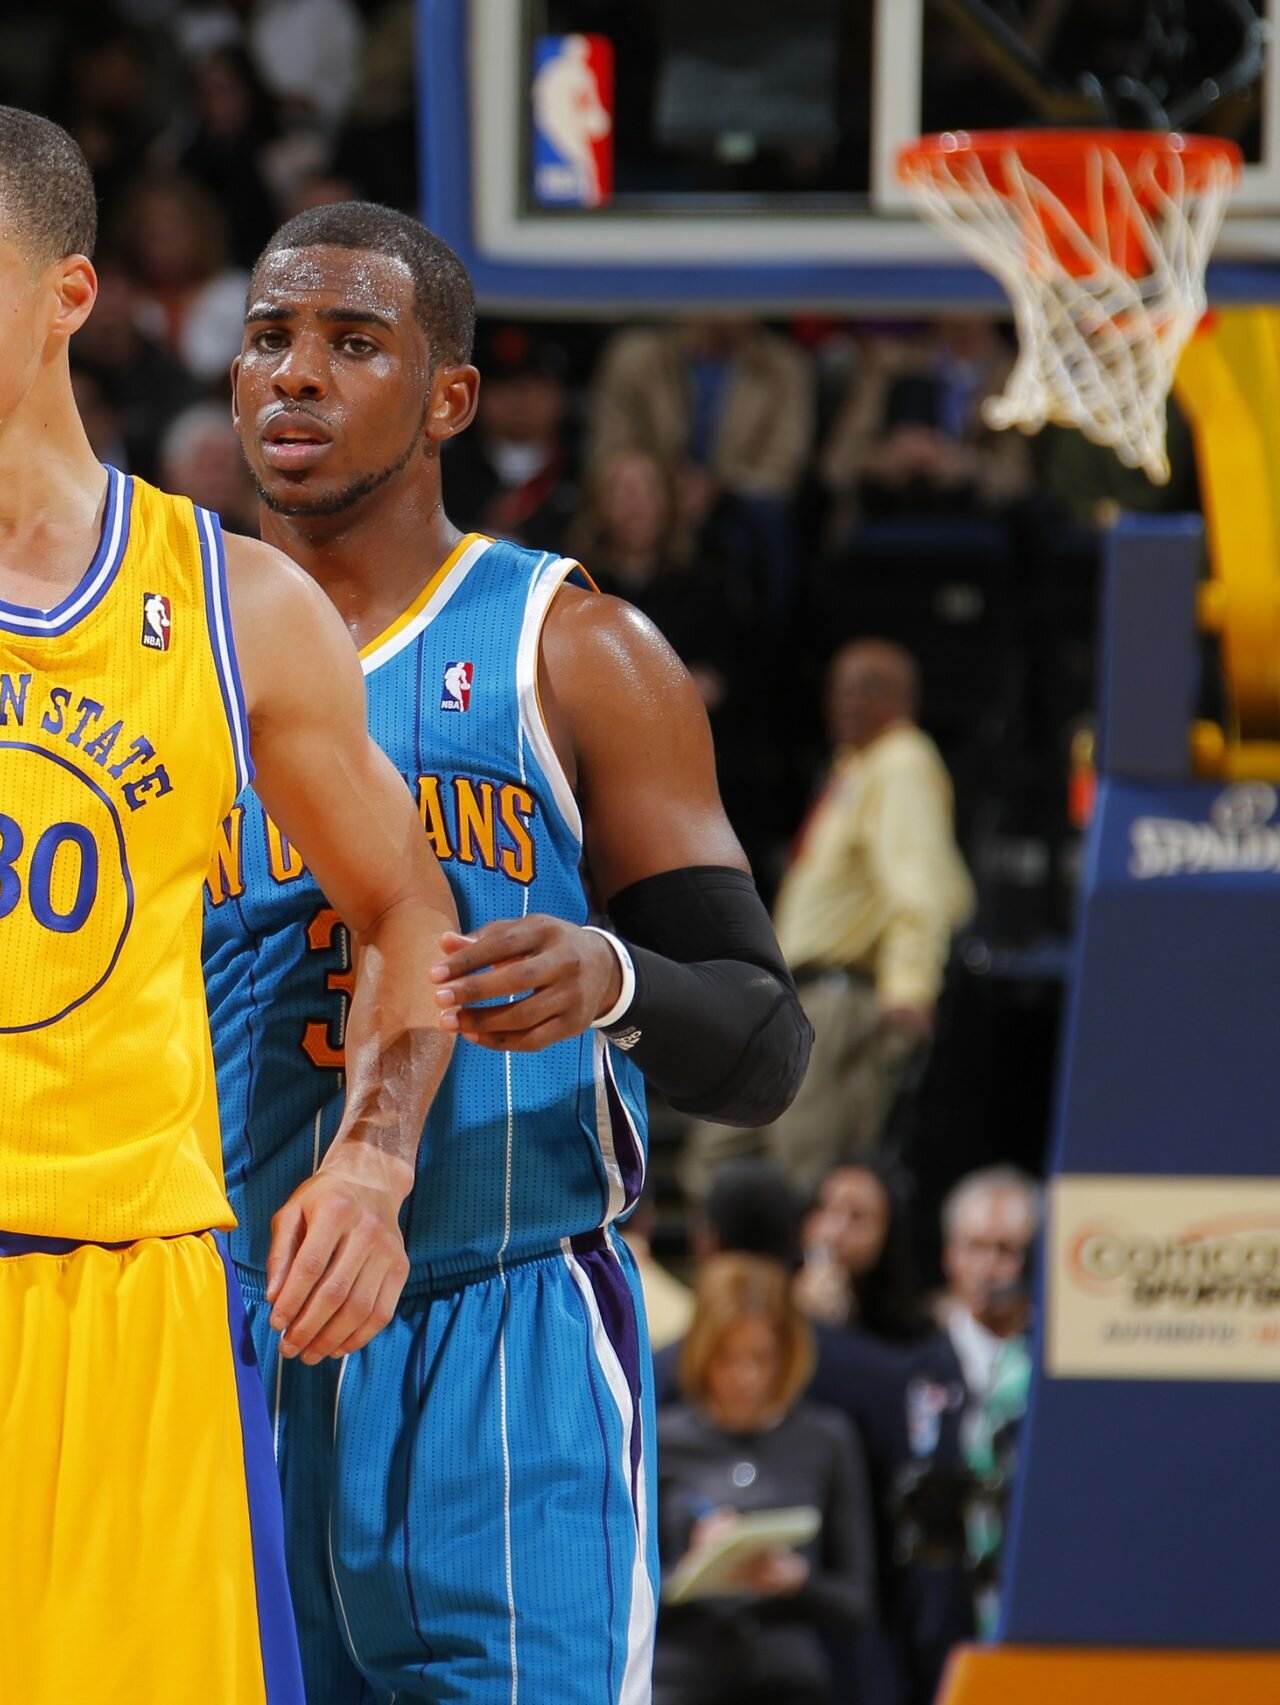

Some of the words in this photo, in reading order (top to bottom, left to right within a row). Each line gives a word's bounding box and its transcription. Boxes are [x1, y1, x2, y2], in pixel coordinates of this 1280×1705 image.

[143, 634, 162, 648] NBA
[440, 699, 461, 710] NBA
[40, 686, 174, 812] STATE
